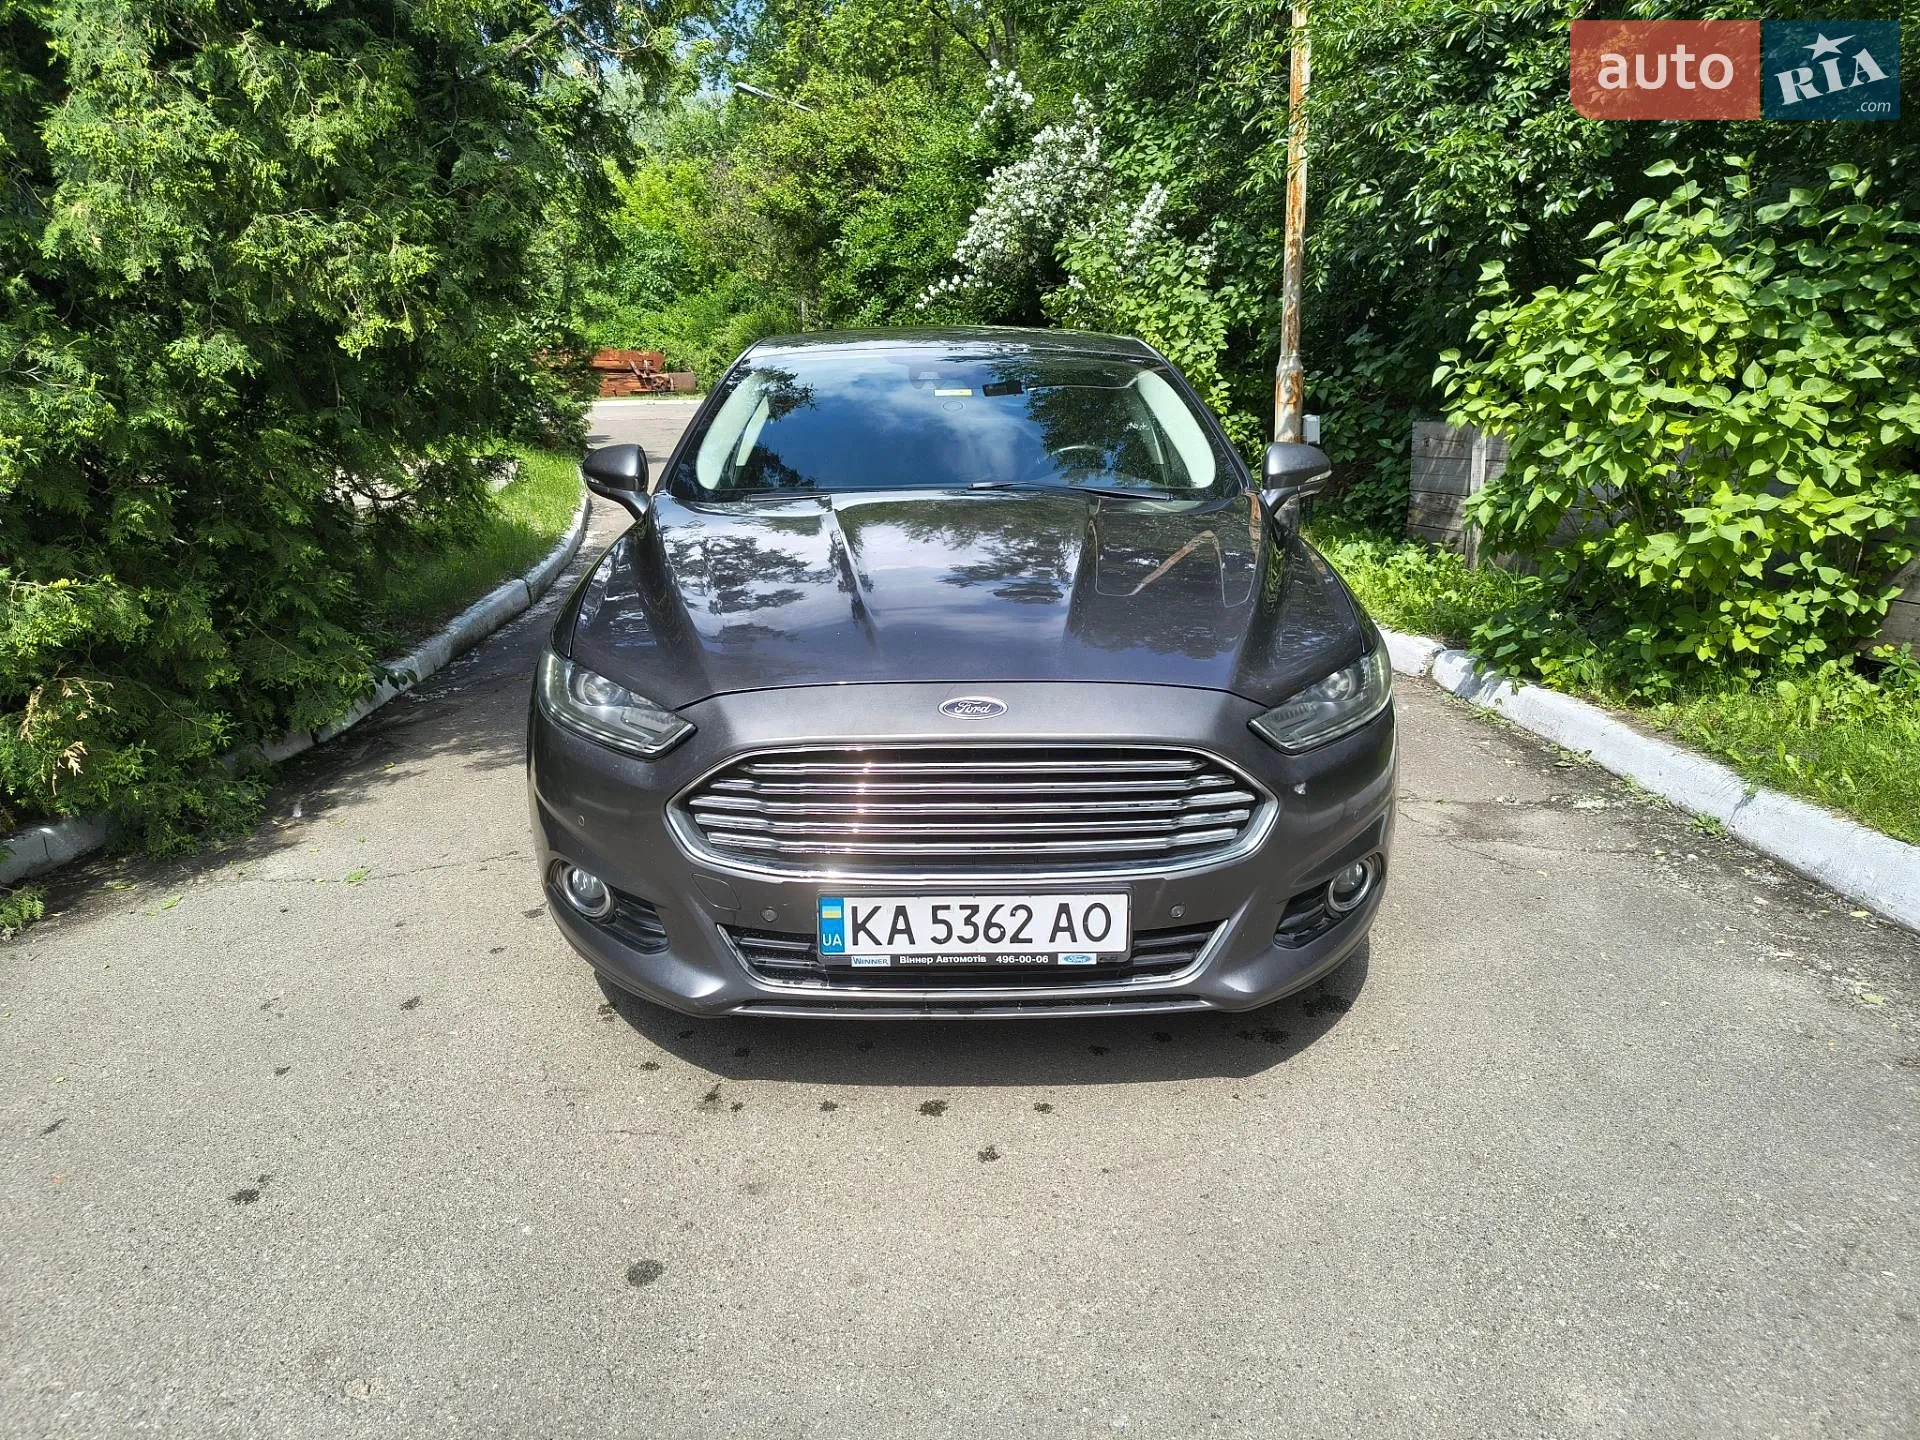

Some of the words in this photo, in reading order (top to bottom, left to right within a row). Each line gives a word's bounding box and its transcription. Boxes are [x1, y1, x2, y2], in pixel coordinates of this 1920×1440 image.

[955, 700, 992, 714] Ford
[851, 905, 916, 946] KA
[930, 904, 1033, 945] 5362
[1049, 903, 1112, 942] AO
[822, 933, 842, 946] UA
[996, 955, 1049, 964] 496-00-06
